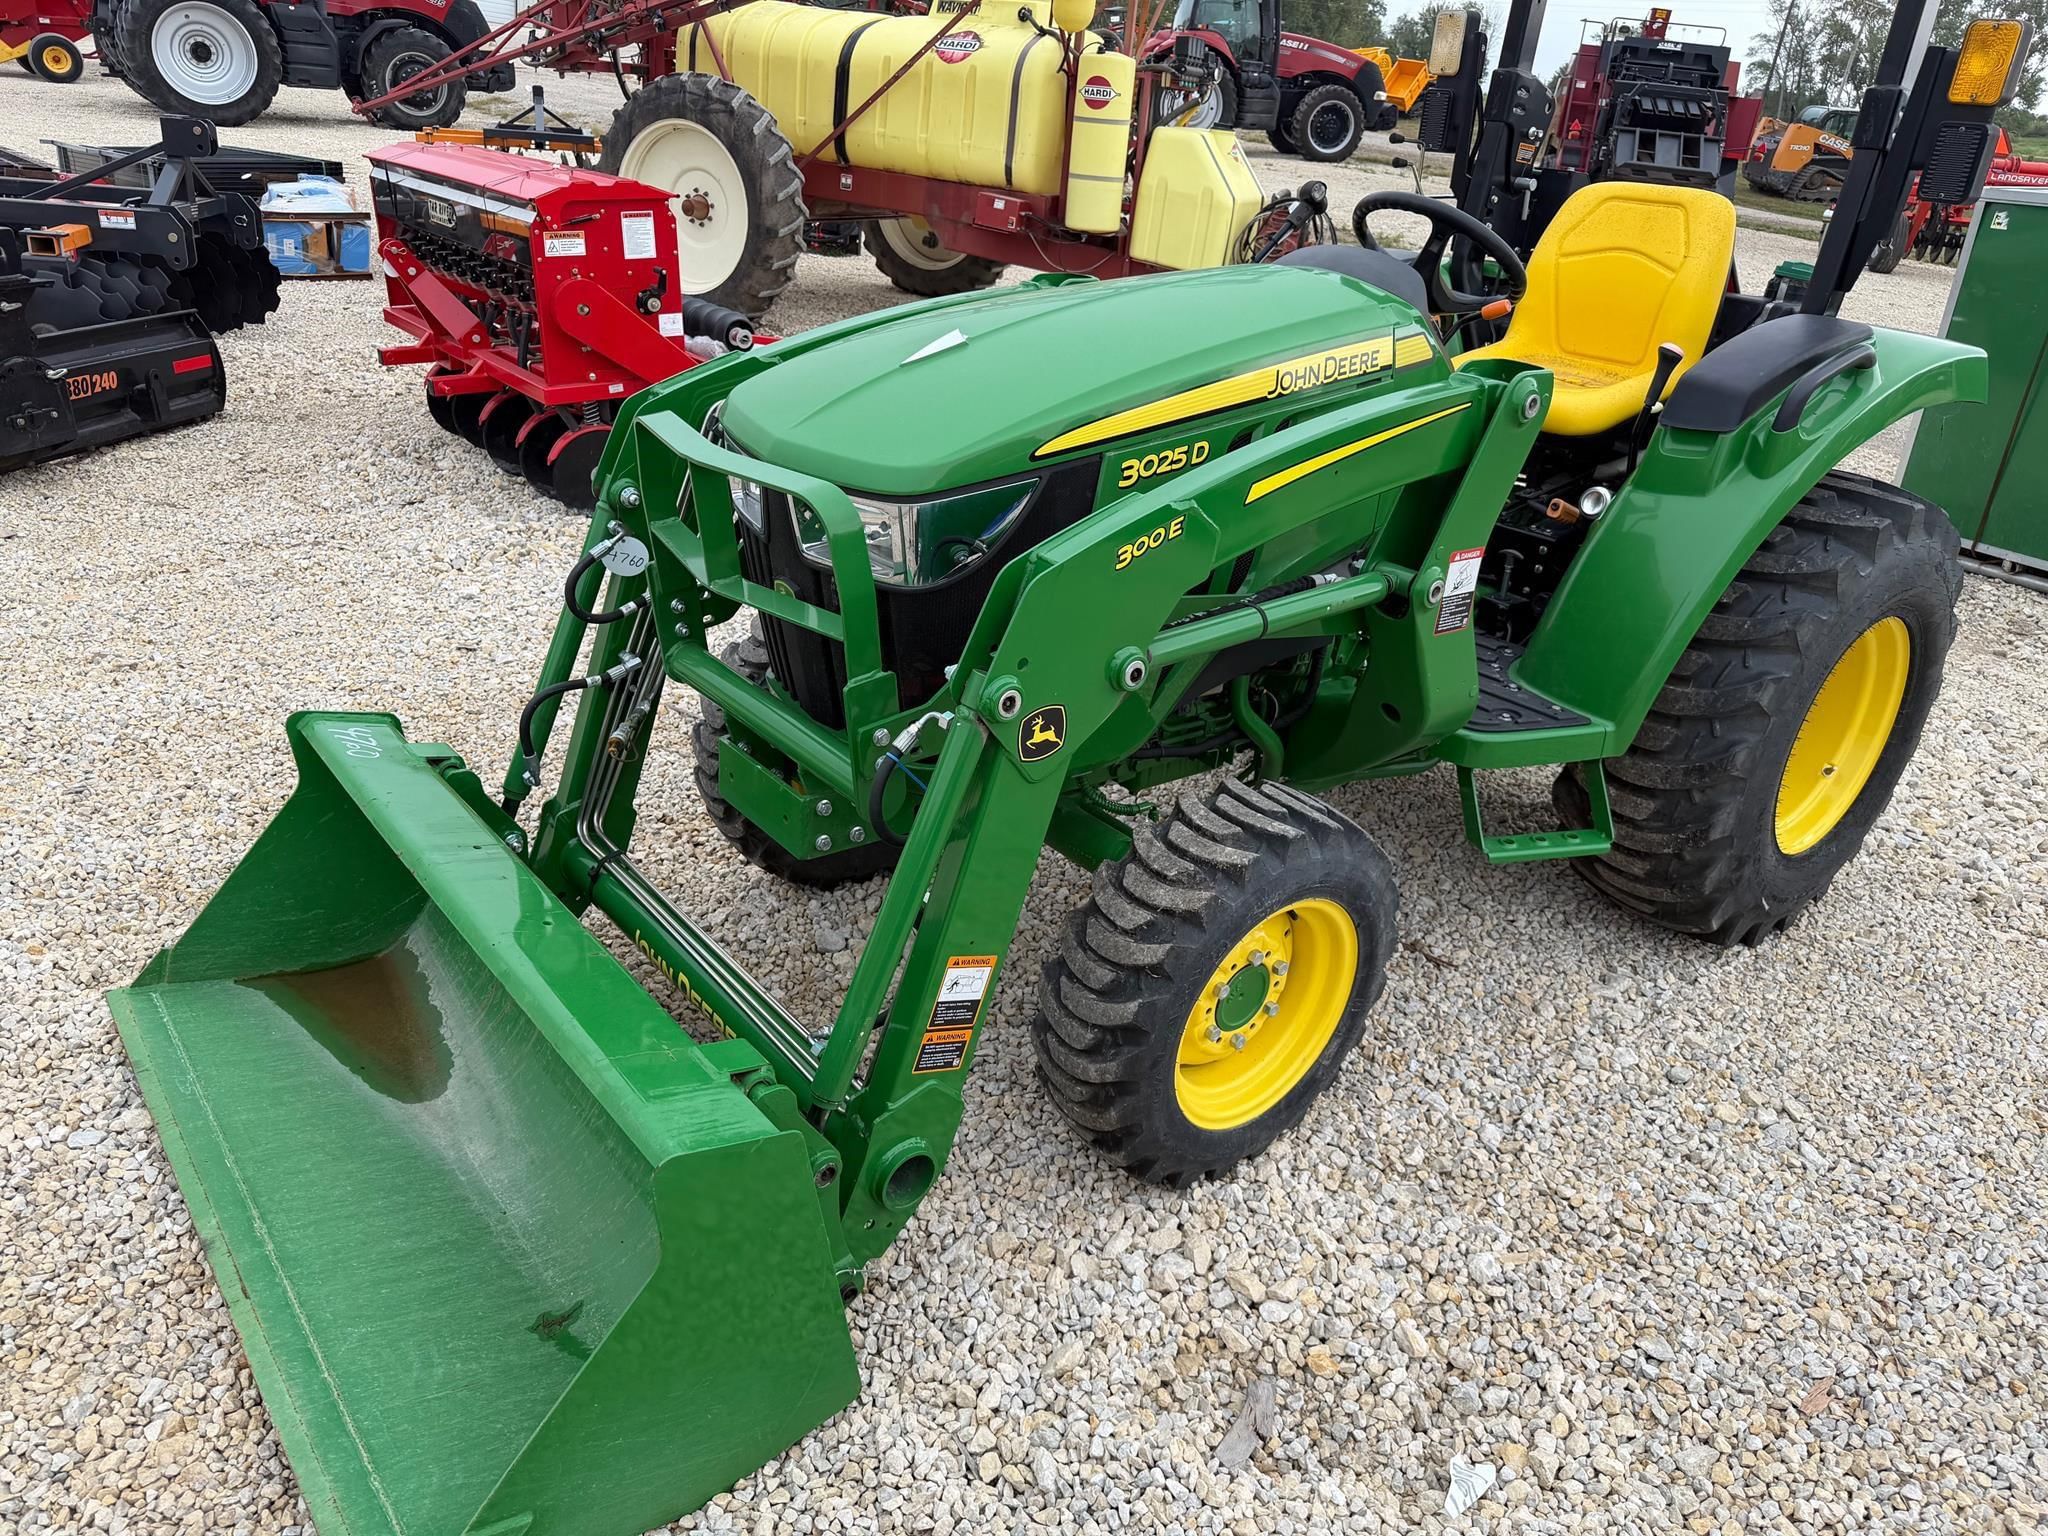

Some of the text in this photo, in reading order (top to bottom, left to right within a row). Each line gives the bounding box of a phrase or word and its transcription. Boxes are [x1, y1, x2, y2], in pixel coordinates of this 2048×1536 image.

[938, 40, 977, 49] HARDI
[1279, 38, 1299, 49] ASE
[1084, 87, 1112, 98] HARDI
[1819, 134, 1850, 152] CASE
[1267, 349, 1381, 396] JOHN DEERE
[92, 370, 118, 393] 240
[1118, 440, 1210, 488] 3025 D
[1115, 515, 1185, 570] 300 E
[608, 551, 645, 568] 4760
[960, 958, 991, 966] WARNING
[936, 1033, 966, 1041] WARNING
